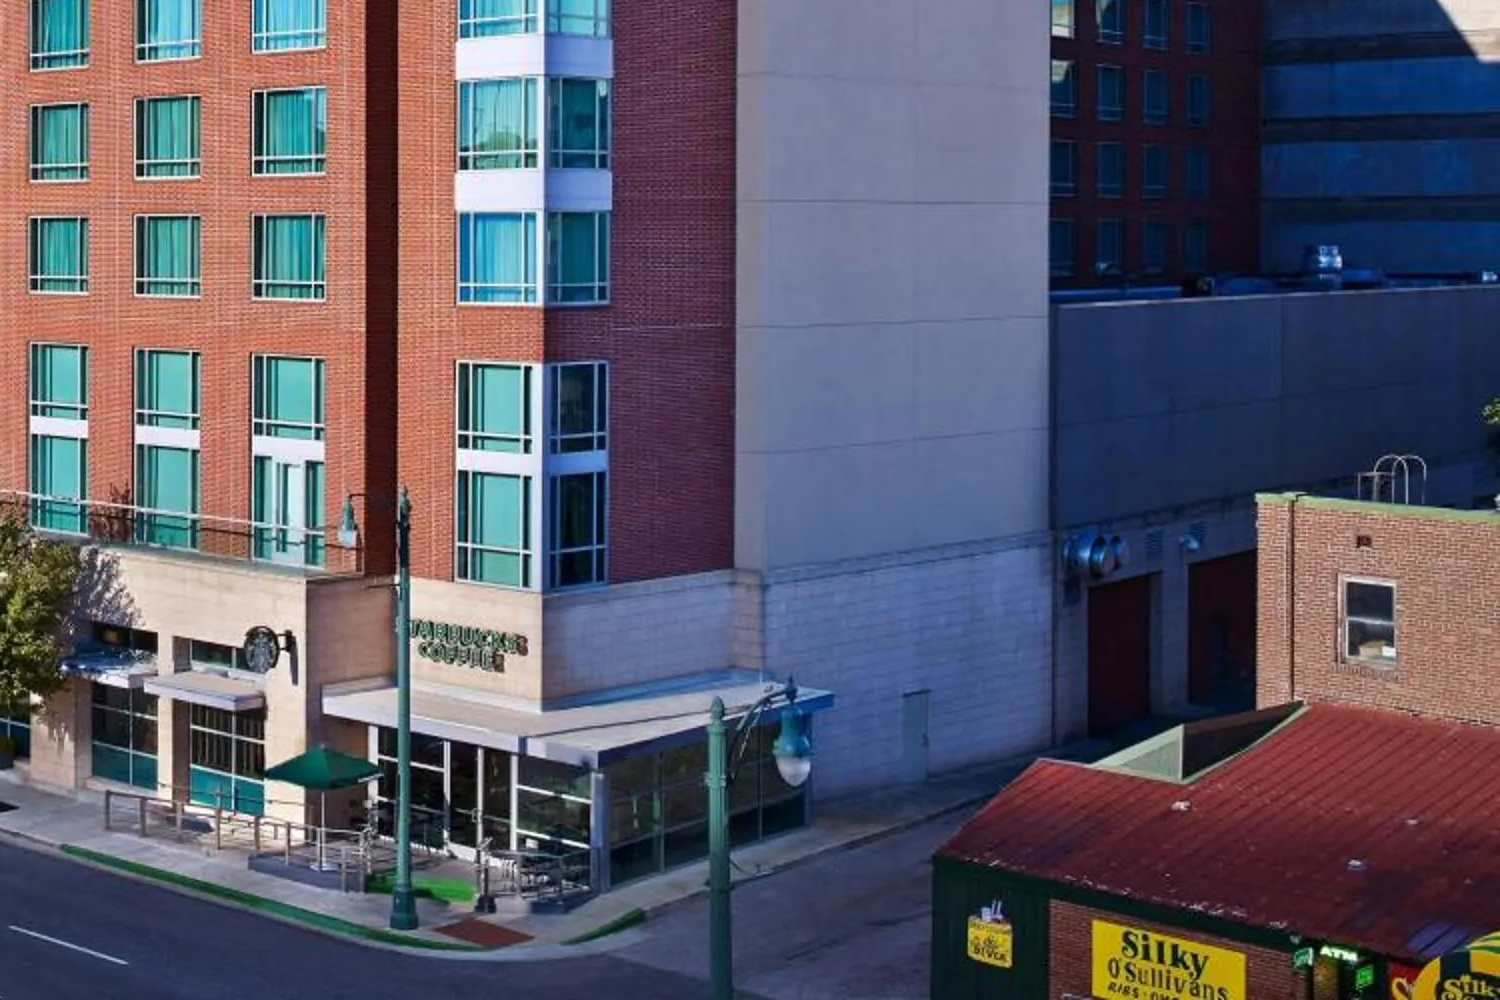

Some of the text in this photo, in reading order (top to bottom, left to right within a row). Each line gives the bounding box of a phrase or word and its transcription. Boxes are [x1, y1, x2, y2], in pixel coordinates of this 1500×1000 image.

[396, 618, 529, 656] TARBUCKS
[418, 641, 505, 673] COFFEE
[1122, 930, 1209, 981] Silky
[1319, 945, 1358, 964] ATM
